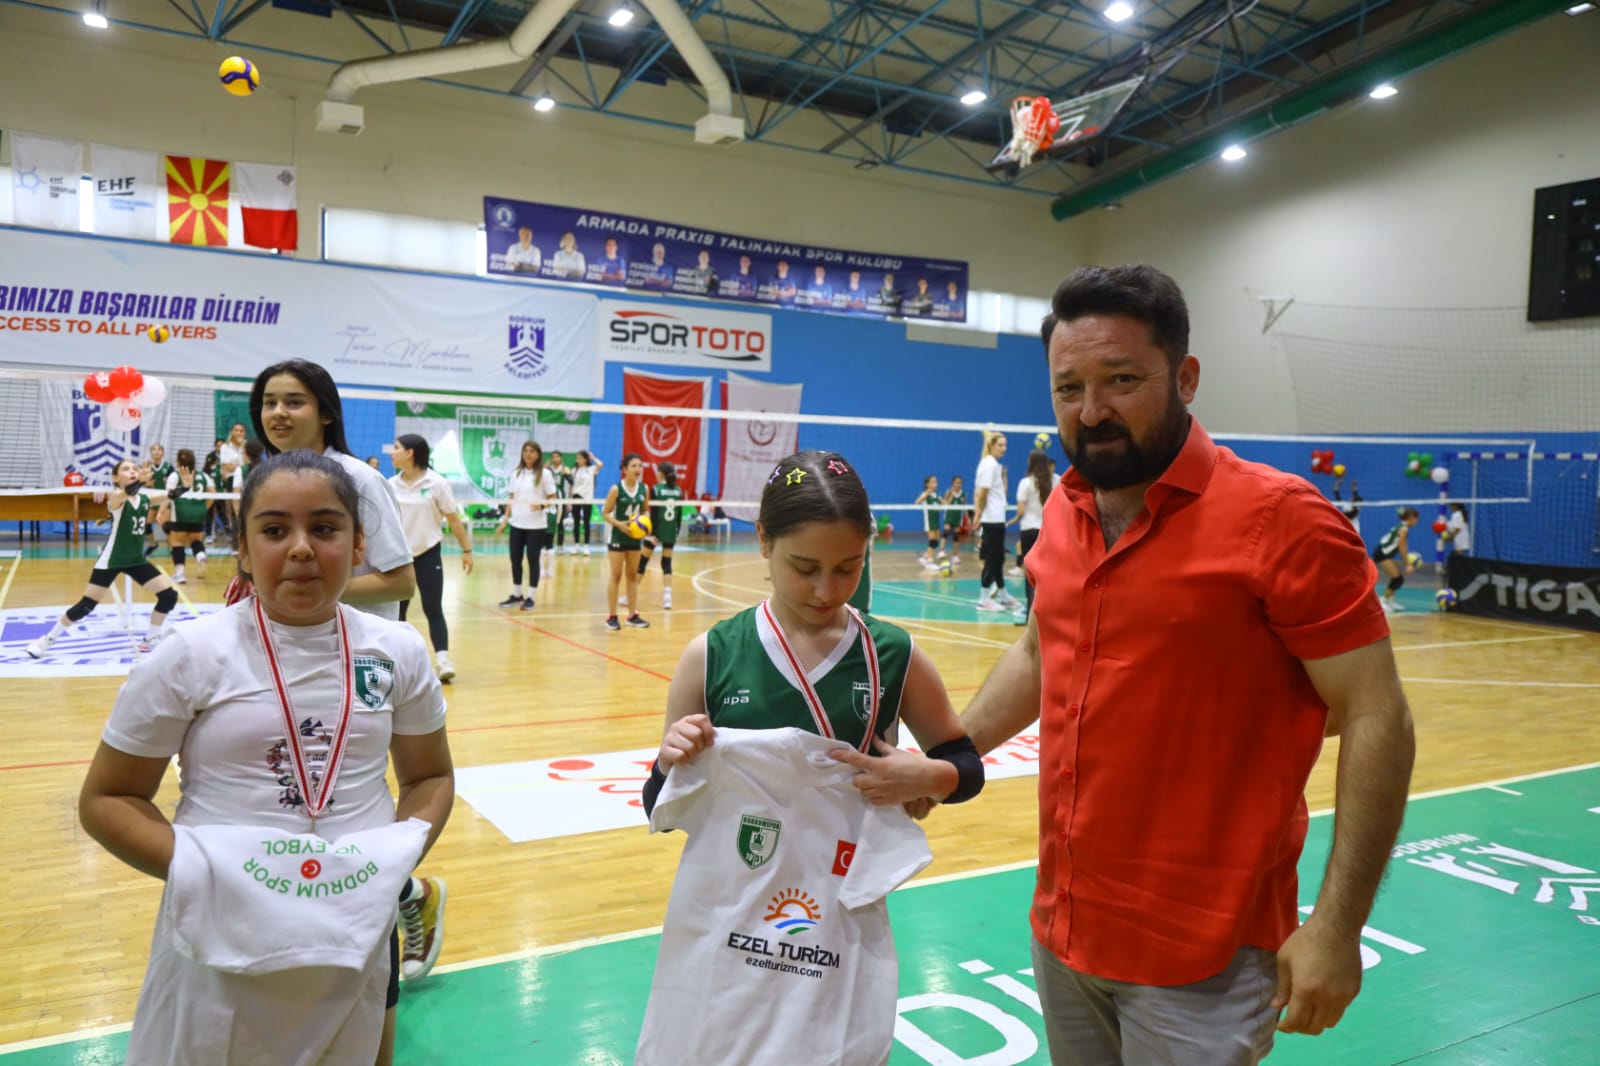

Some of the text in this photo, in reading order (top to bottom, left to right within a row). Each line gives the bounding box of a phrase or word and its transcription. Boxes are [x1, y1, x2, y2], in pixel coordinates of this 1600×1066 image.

[97, 177, 136, 192] EHF
[576, 214, 649, 236] ARMADA
[654, 225, 714, 247] PRAXIS
[719, 236, 802, 257] YALIKAVAK
[805, 250, 845, 263] SPOR
[0, 285, 281, 325] RIMIZA BAŞARILAR DİLERİM
[66, 319, 92, 334] TO
[95, 321, 131, 336] ALL
[1459, 573, 1600, 617] STIGA
[243, 858, 379, 897] BODRUM SPOR
[728, 932, 840, 969] EZEL TURİZM
[745, 957, 823, 979] ezelturizm.com
